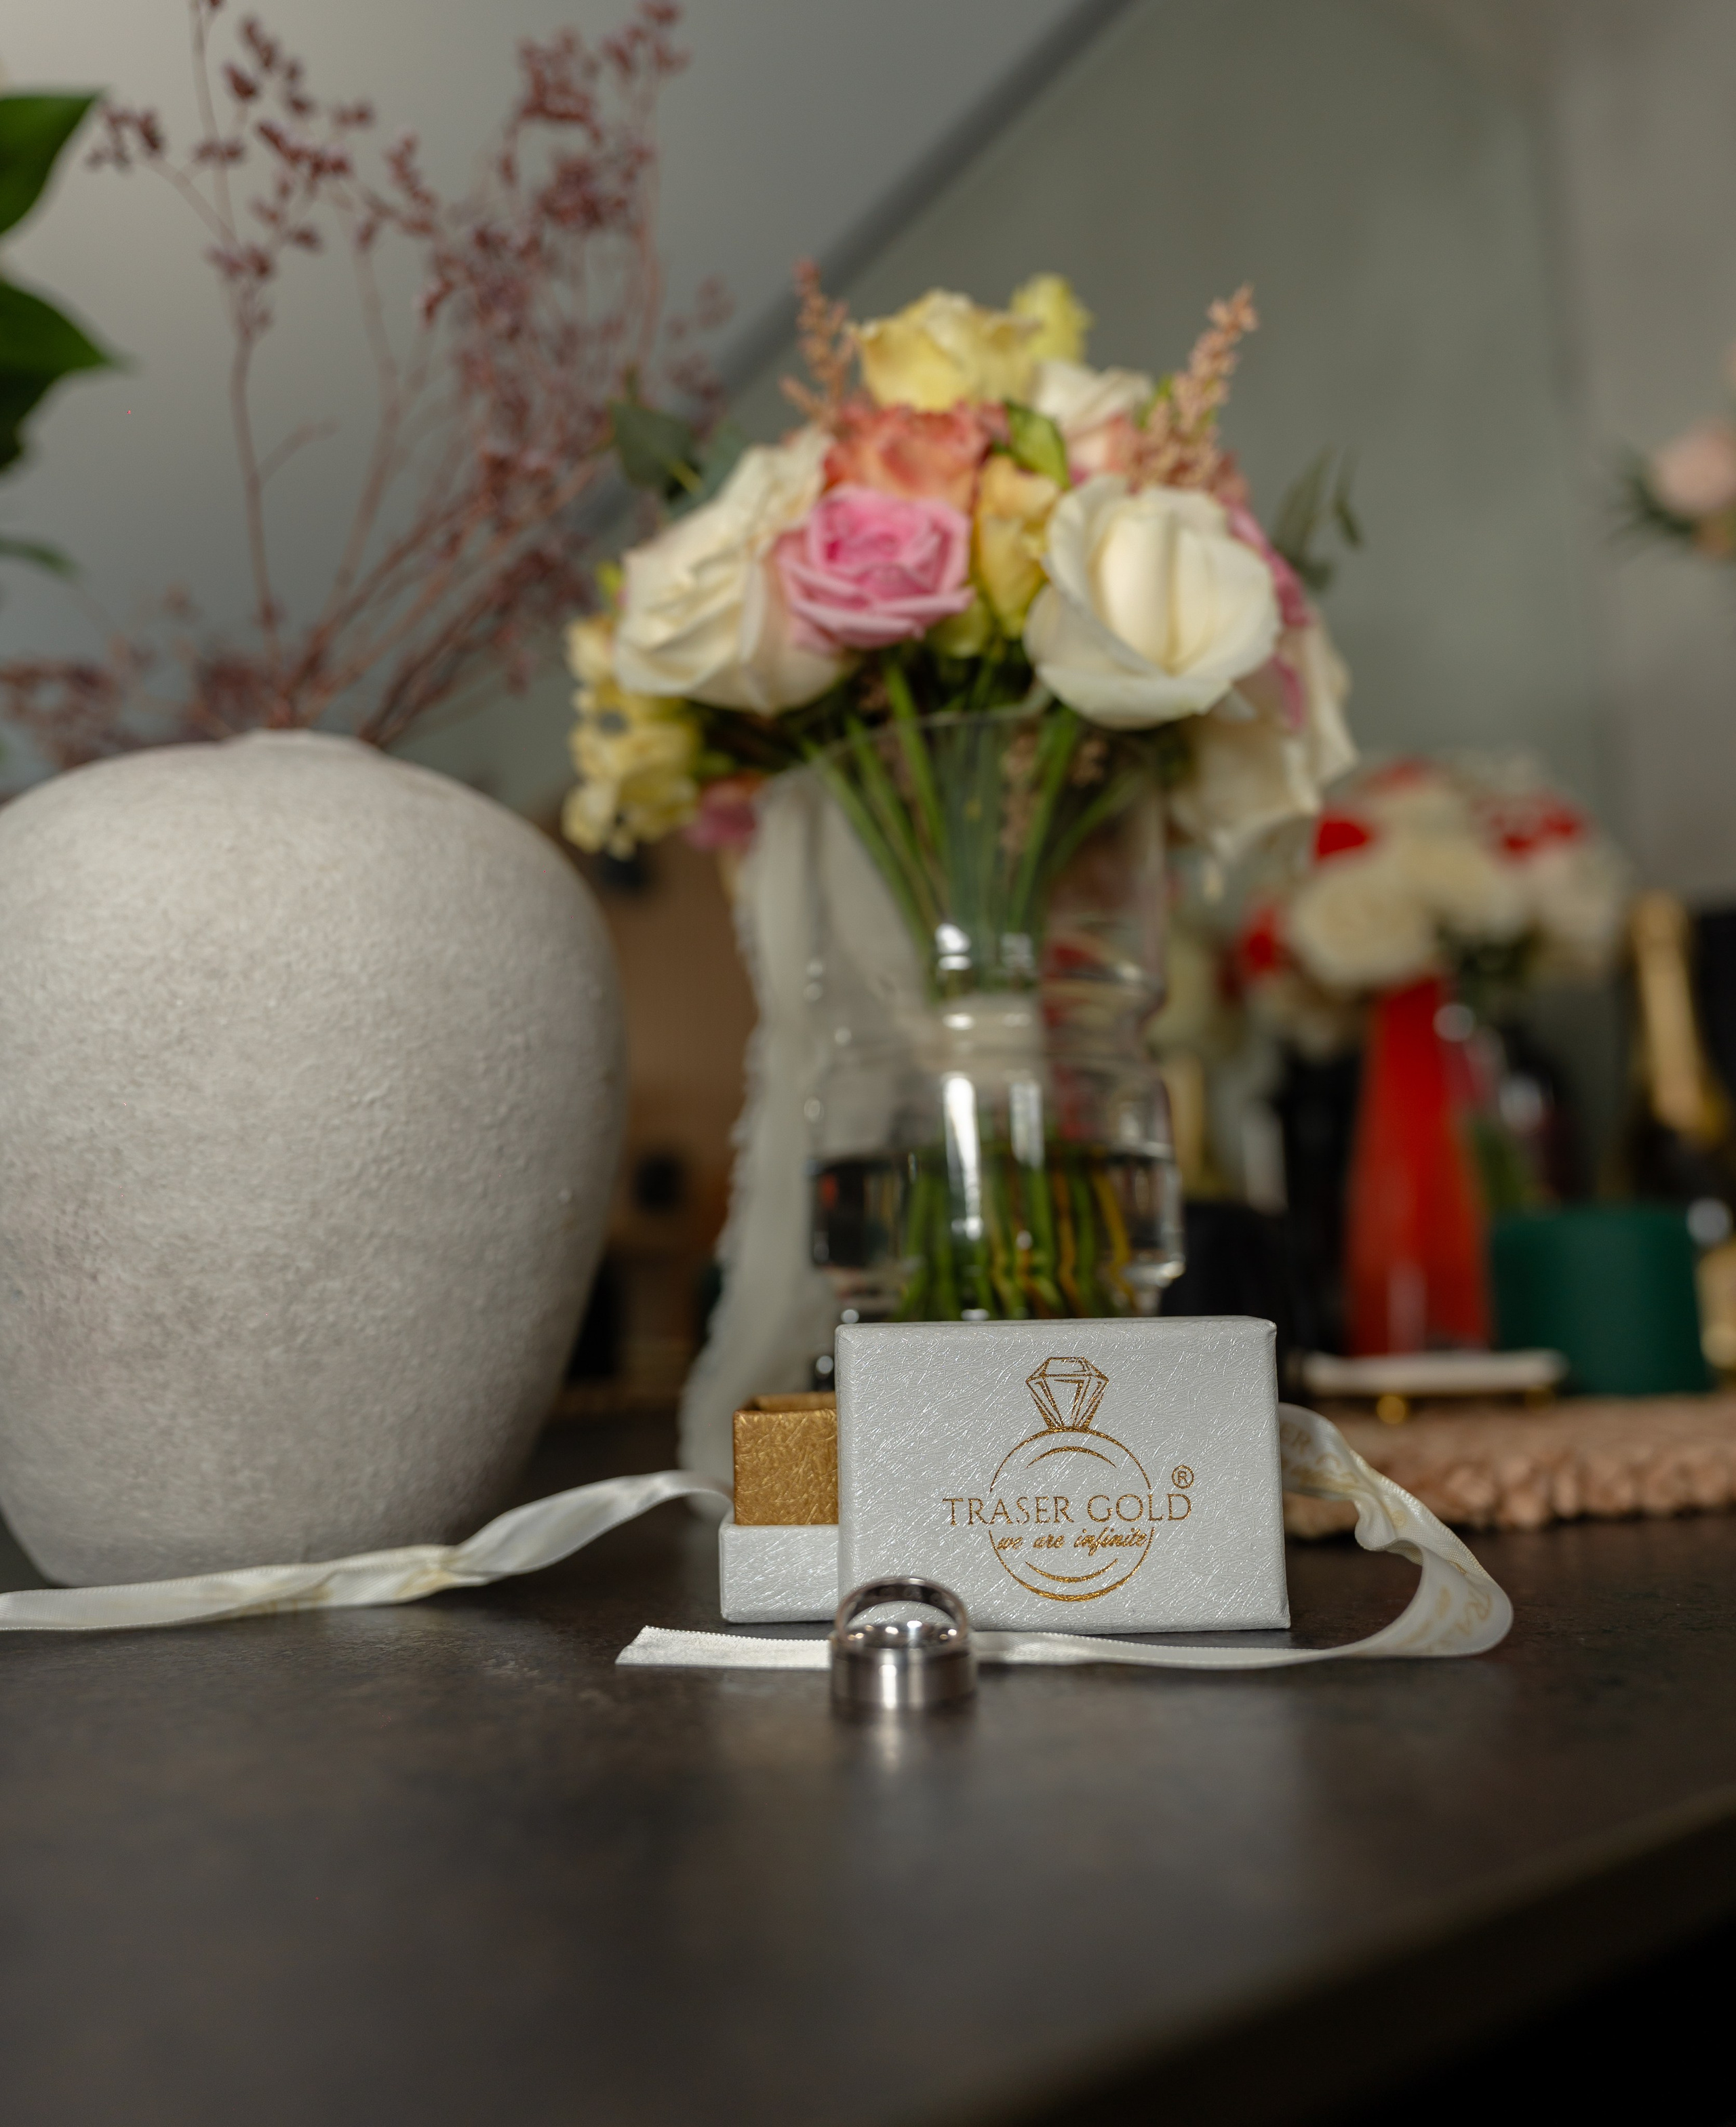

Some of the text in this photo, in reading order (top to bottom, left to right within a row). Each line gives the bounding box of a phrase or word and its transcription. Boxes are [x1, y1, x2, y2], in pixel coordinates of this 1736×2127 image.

[942, 1495, 1074, 1526] TRASER
[1087, 1493, 1193, 1523] GOLD
[996, 1526, 1148, 1556] we are infinite
